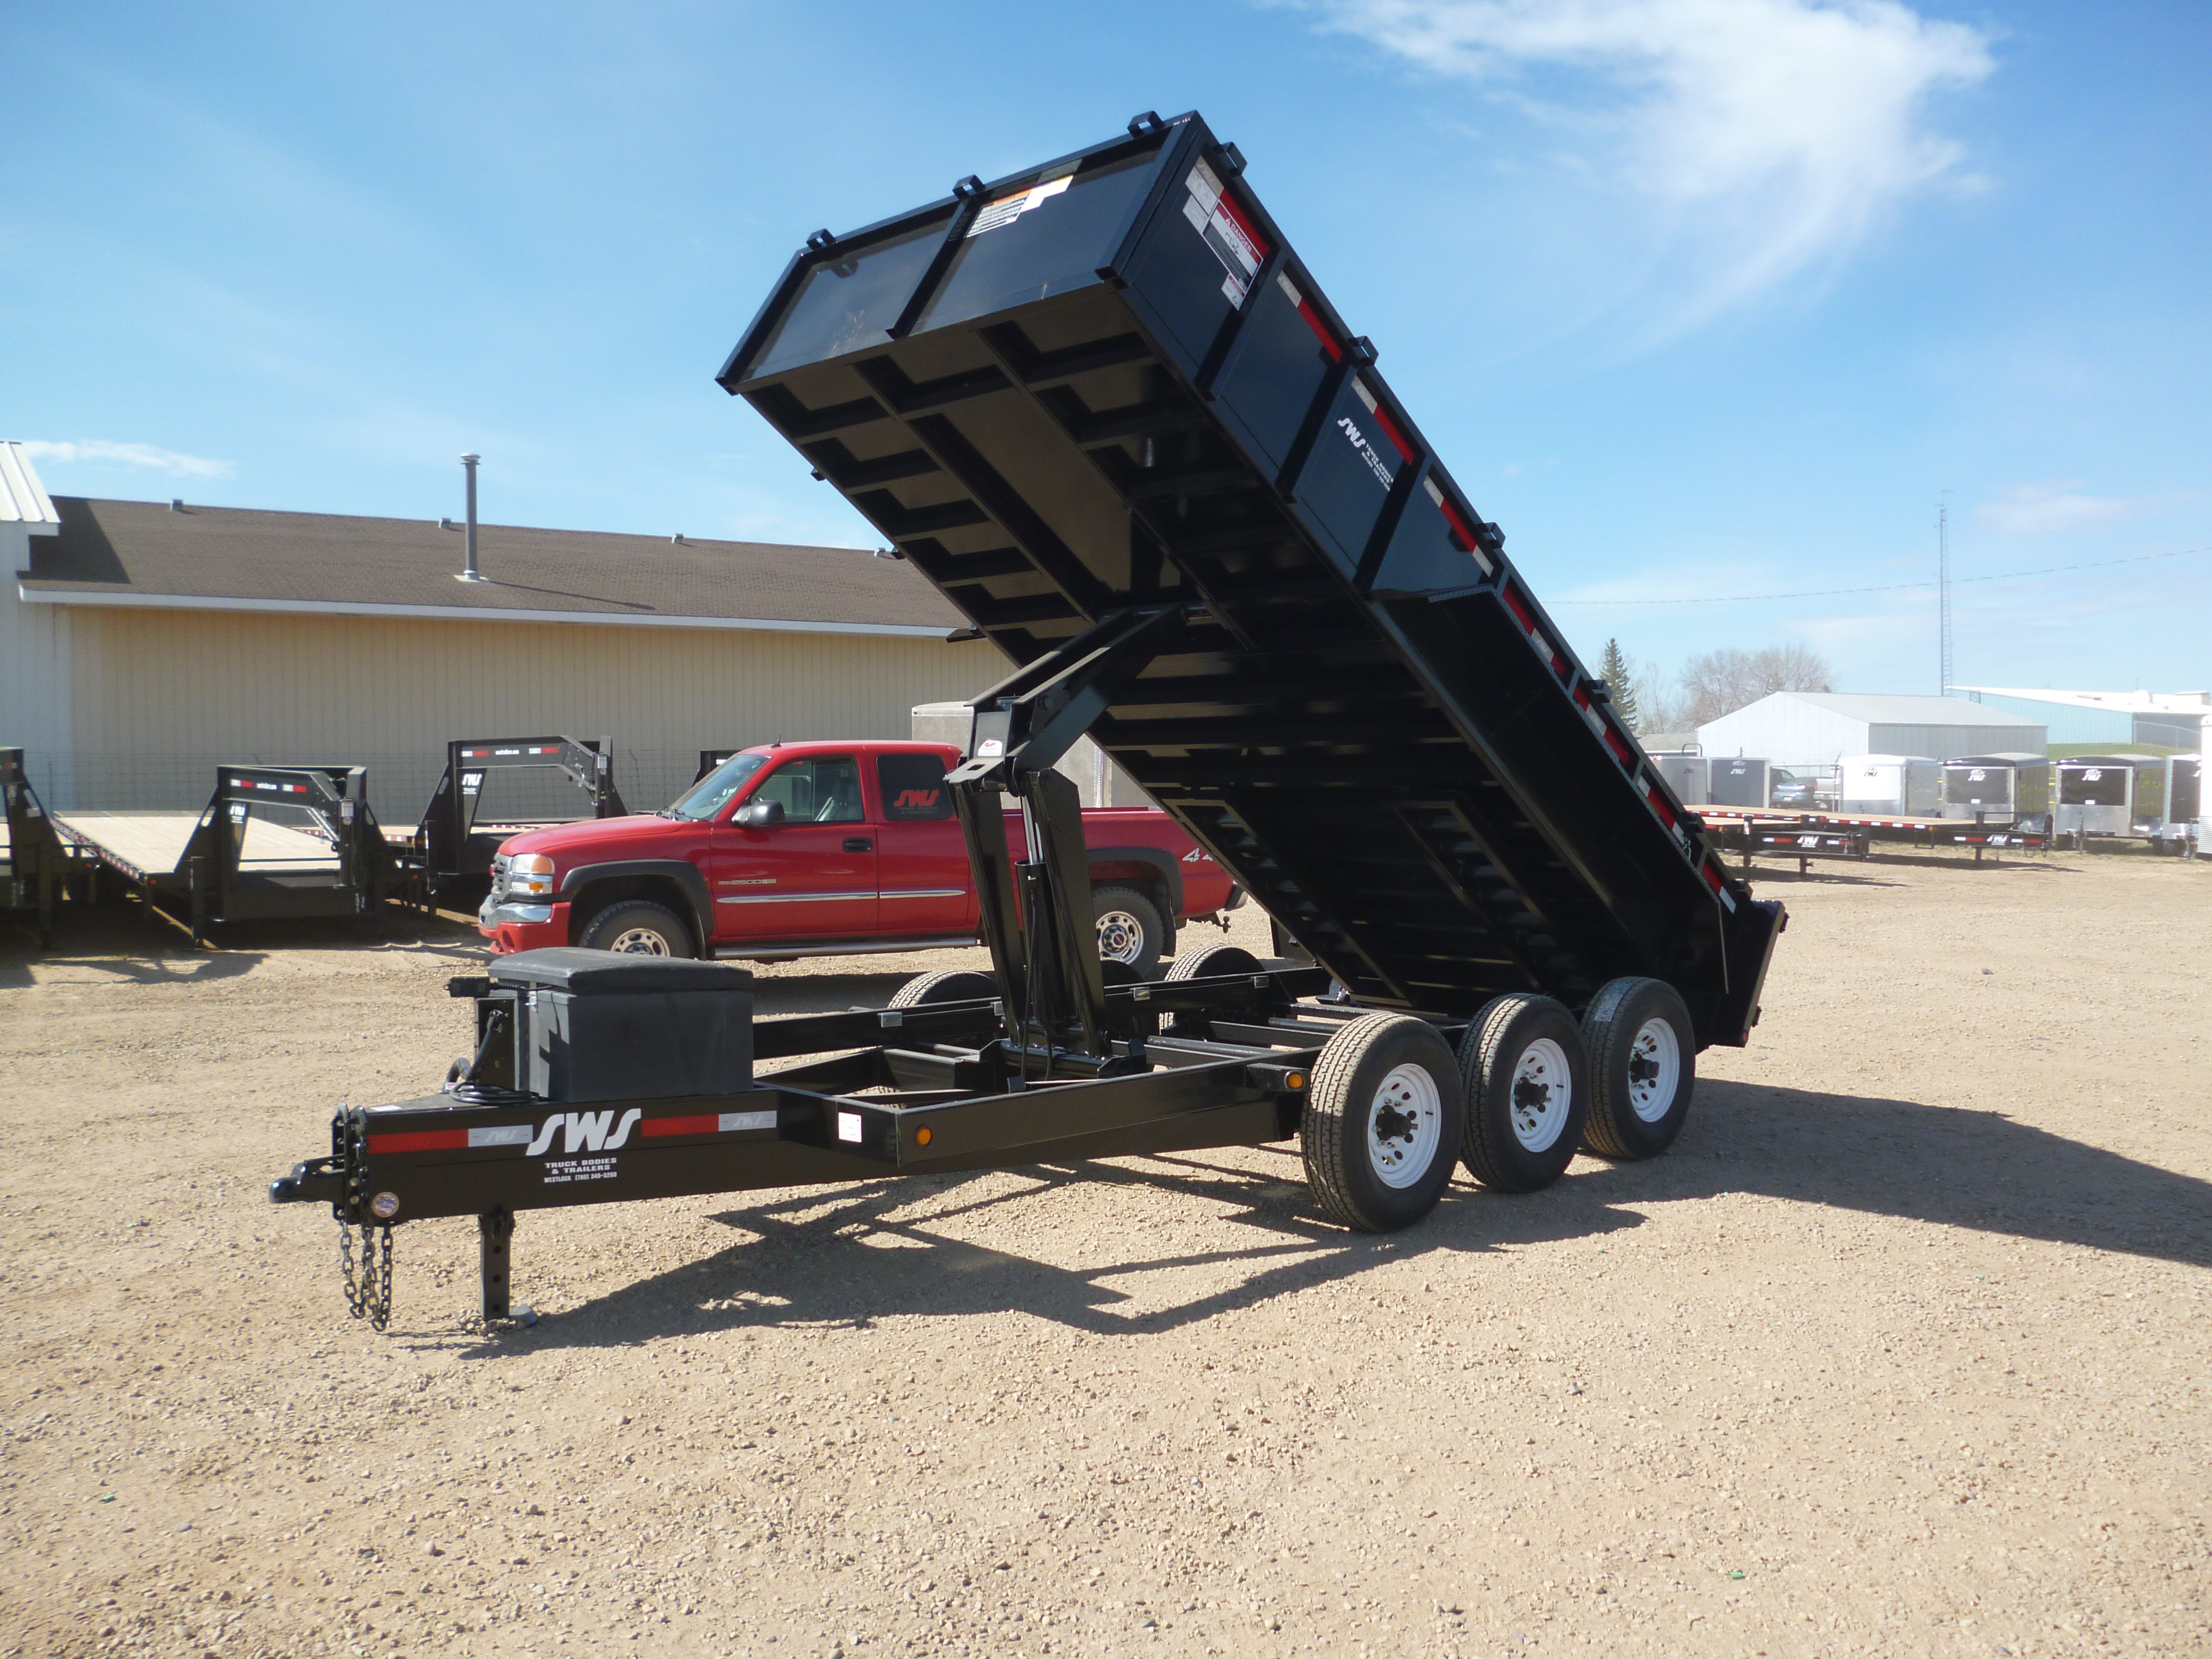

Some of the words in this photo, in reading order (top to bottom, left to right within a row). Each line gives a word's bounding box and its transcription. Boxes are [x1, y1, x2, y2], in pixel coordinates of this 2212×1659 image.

[1231, 223, 1252, 252] DANGER
[1337, 417, 1366, 448] SWS
[1366, 443, 1379, 462] TRUCK
[1379, 462, 1394, 483] BODIES
[1371, 457, 1390, 483] TRAILERS
[462, 774, 483, 785] SWS
[894, 790, 940, 807] SWS
[525, 1108, 642, 1156] SWS
[563, 1164, 610, 1173] TRAILERS
